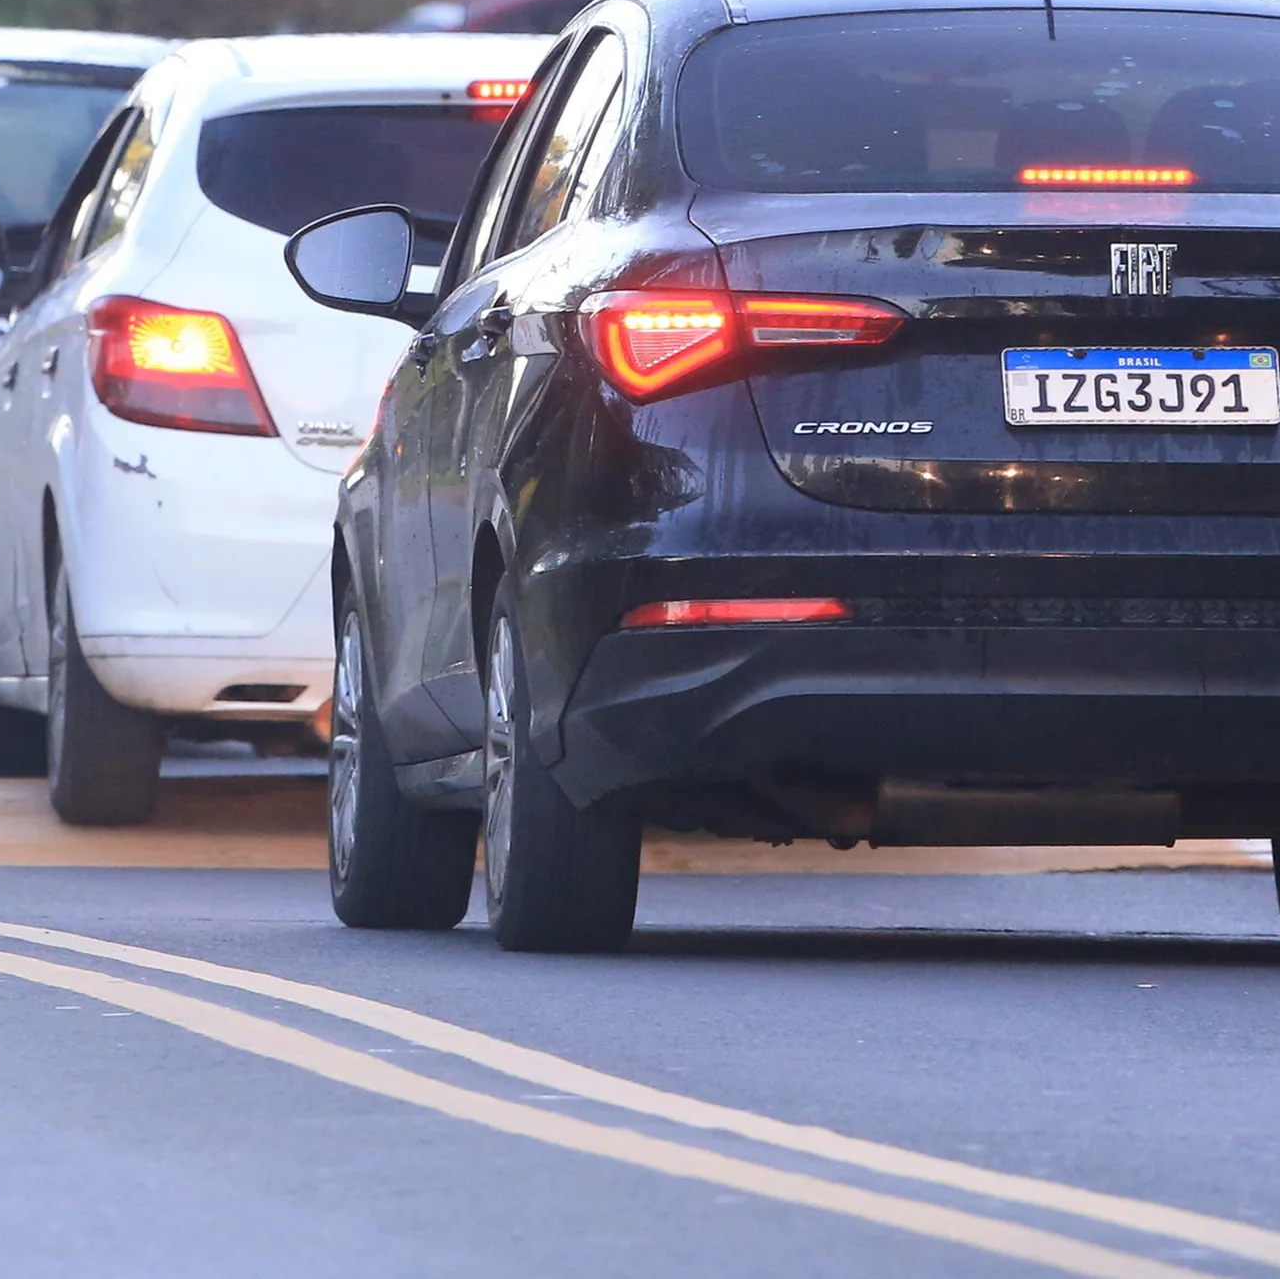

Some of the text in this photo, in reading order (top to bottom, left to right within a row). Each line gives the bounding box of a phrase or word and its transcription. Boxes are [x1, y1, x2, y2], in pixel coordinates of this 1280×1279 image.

[1110, 243, 1178, 295] FIAT
[1118, 357, 1162, 367] BRASIL
[1031, 373, 1249, 413] IZG3J91
[1010, 408, 1026, 421] BR
[793, 421, 934, 434] CRONOS
